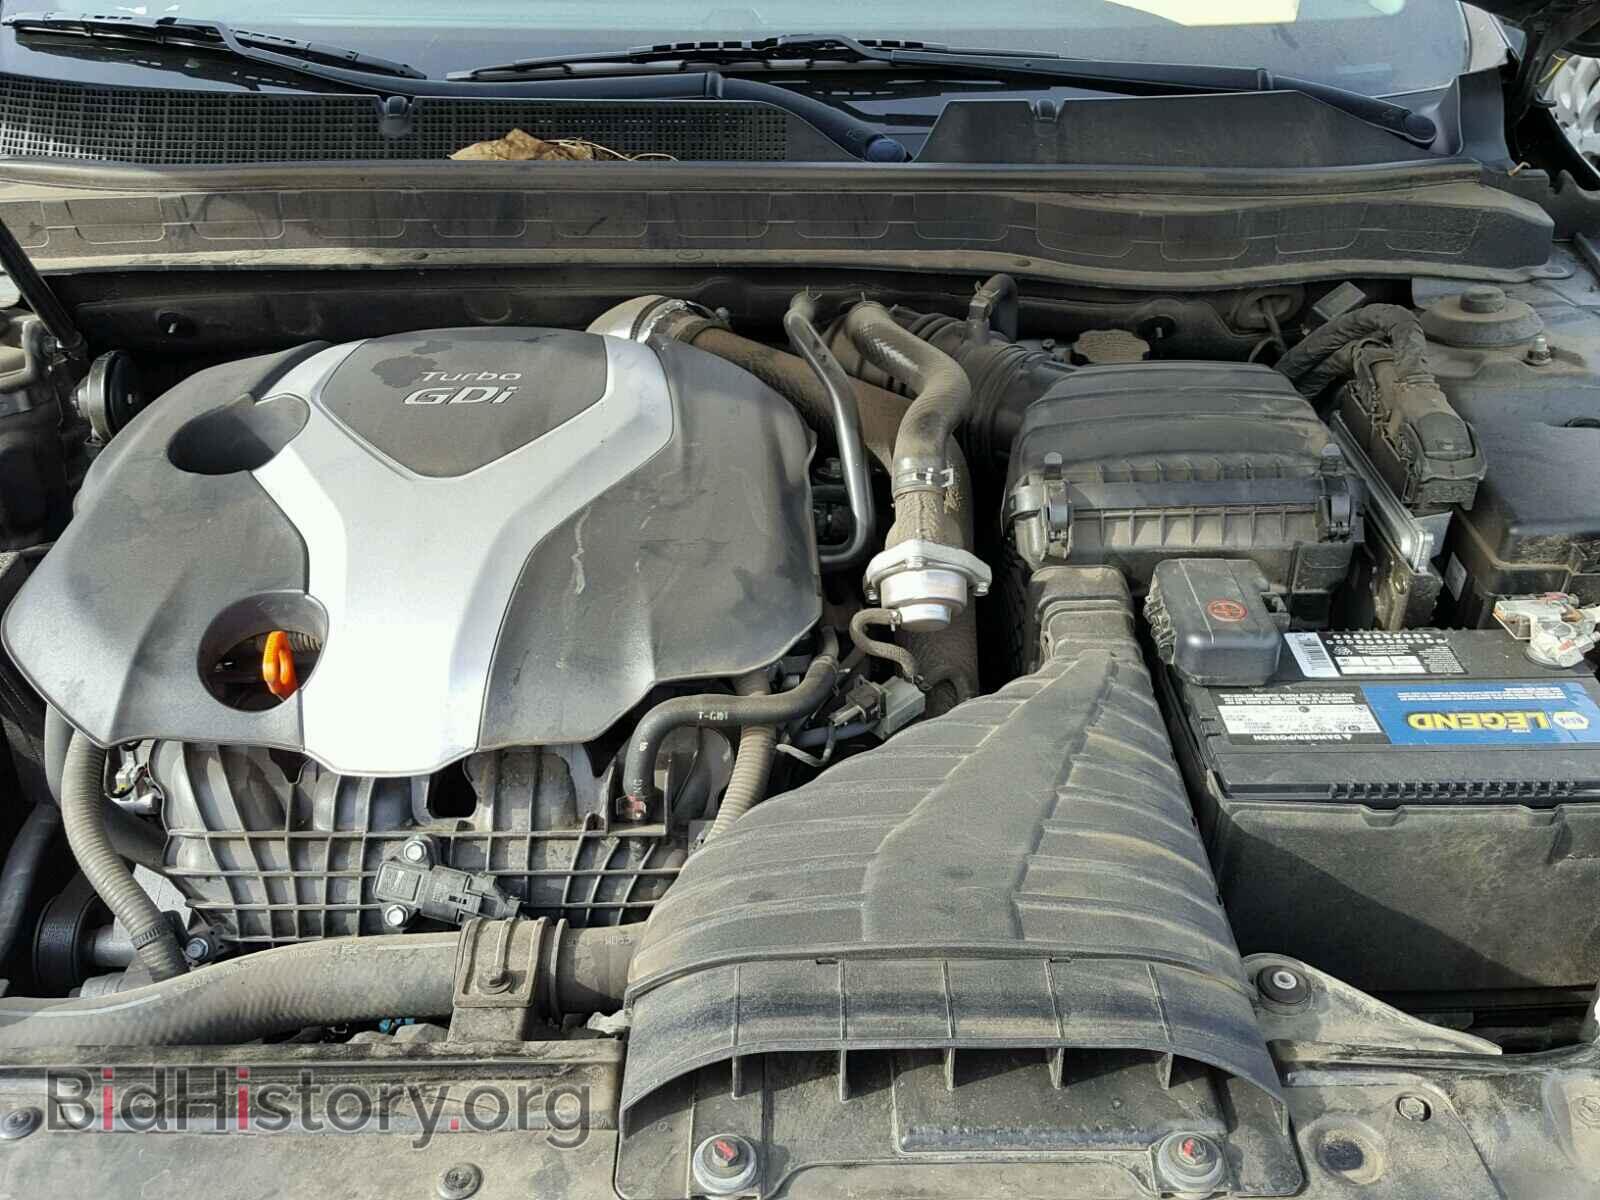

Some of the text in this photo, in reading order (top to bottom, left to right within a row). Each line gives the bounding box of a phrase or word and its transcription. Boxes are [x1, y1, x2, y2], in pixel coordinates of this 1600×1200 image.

[420, 371, 522, 382] Turbo
[403, 386, 520, 406] GDi
[1407, 711, 1549, 730] LEGEND
